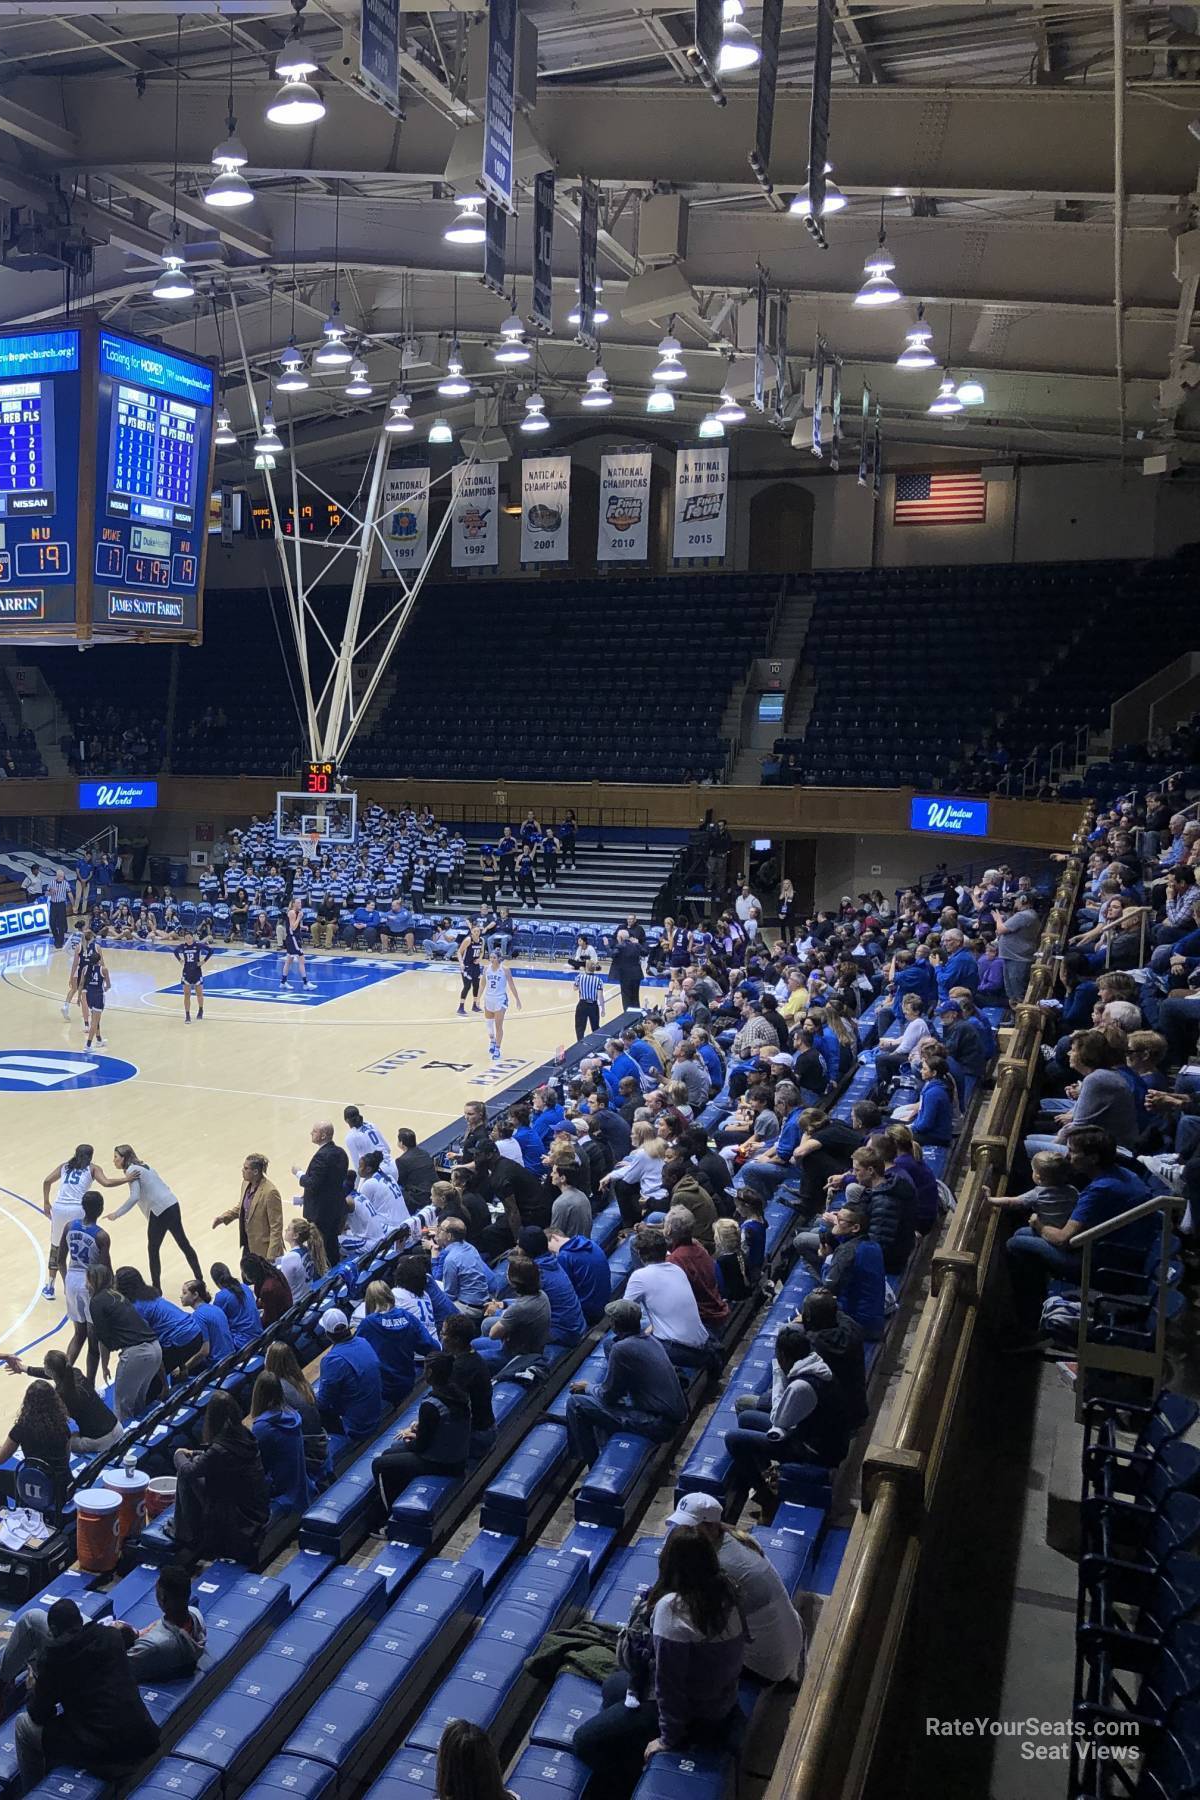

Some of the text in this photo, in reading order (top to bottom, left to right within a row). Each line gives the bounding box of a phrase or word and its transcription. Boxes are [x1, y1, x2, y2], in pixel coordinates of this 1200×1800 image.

[140, 359, 164, 376] HOPE?
[4, 413, 20, 424] REB
[23, 411, 39, 422] FLS
[9, 426, 15, 436] 4
[29, 438, 35, 448] 2
[10, 452, 16, 462] 4
[29, 451, 35, 461] 0
[10, 465, 16, 474] 0
[30, 464, 35, 473] 0
[608, 467, 643, 476] NATIONAL
[30, 477, 36, 486] 0
[390, 481, 424, 490] NATIONAL
[524, 481, 567, 492] CHAMPIONS
[603, 478, 648, 488] CHAMPIONS
[386, 492, 426, 502] CHAMPIONS
[13, 499, 48, 508] NISSAN
[618, 498, 642, 508] FINAL
[252, 508, 270, 516] DUKE
[608, 506, 641, 518] FOUR
[688, 504, 720, 518] FOUR
[262, 518, 272, 529] 17
[330, 515, 340, 526] 19
[32, 528, 51, 540] NU
[102, 528, 120, 541] DUKE
[689, 535, 712, 544] 2015
[534, 540, 554, 550] 2001
[612, 539, 635, 548] 2010
[395, 548, 414, 558] 1991
[464, 545, 486, 554] 1992
[40, 546, 59, 570] 19
[109, 549, 120, 571] 17
[182, 560, 192, 580] 19
[112, 596, 181, 616] JAMES SCOTT FARRIN
[310, 764, 332, 774] 4:19
[309, 774, 326, 792] 30
[186, 954, 194, 962] 12
[366, 1049, 428, 1075] COURT
[420, 1060, 474, 1072] K
[467, 1058, 527, 1086] COACH
[368, 1130, 379, 1146] 0
[64, 1170, 82, 1185] 15
[70, 1243, 90, 1264] 24
[417, 1300, 435, 1323] 15
